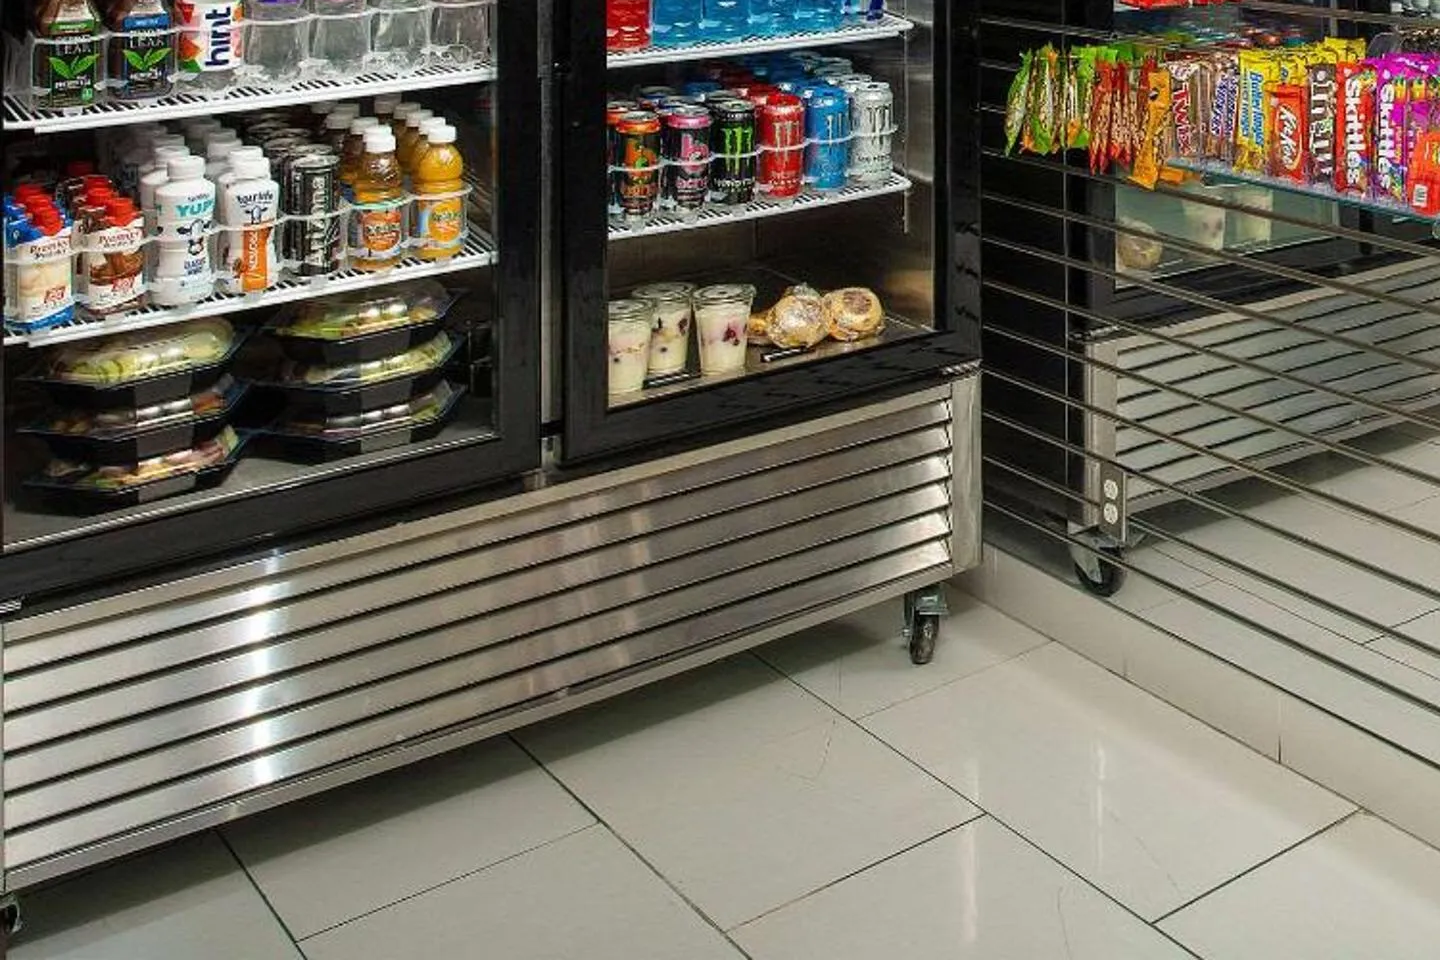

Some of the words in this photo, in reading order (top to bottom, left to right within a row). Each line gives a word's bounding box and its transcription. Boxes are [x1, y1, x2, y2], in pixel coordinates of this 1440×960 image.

[204, 6, 232, 68] hint
[1345, 78, 1364, 185] Skittles
[1377, 83, 1396, 190] Skittles
